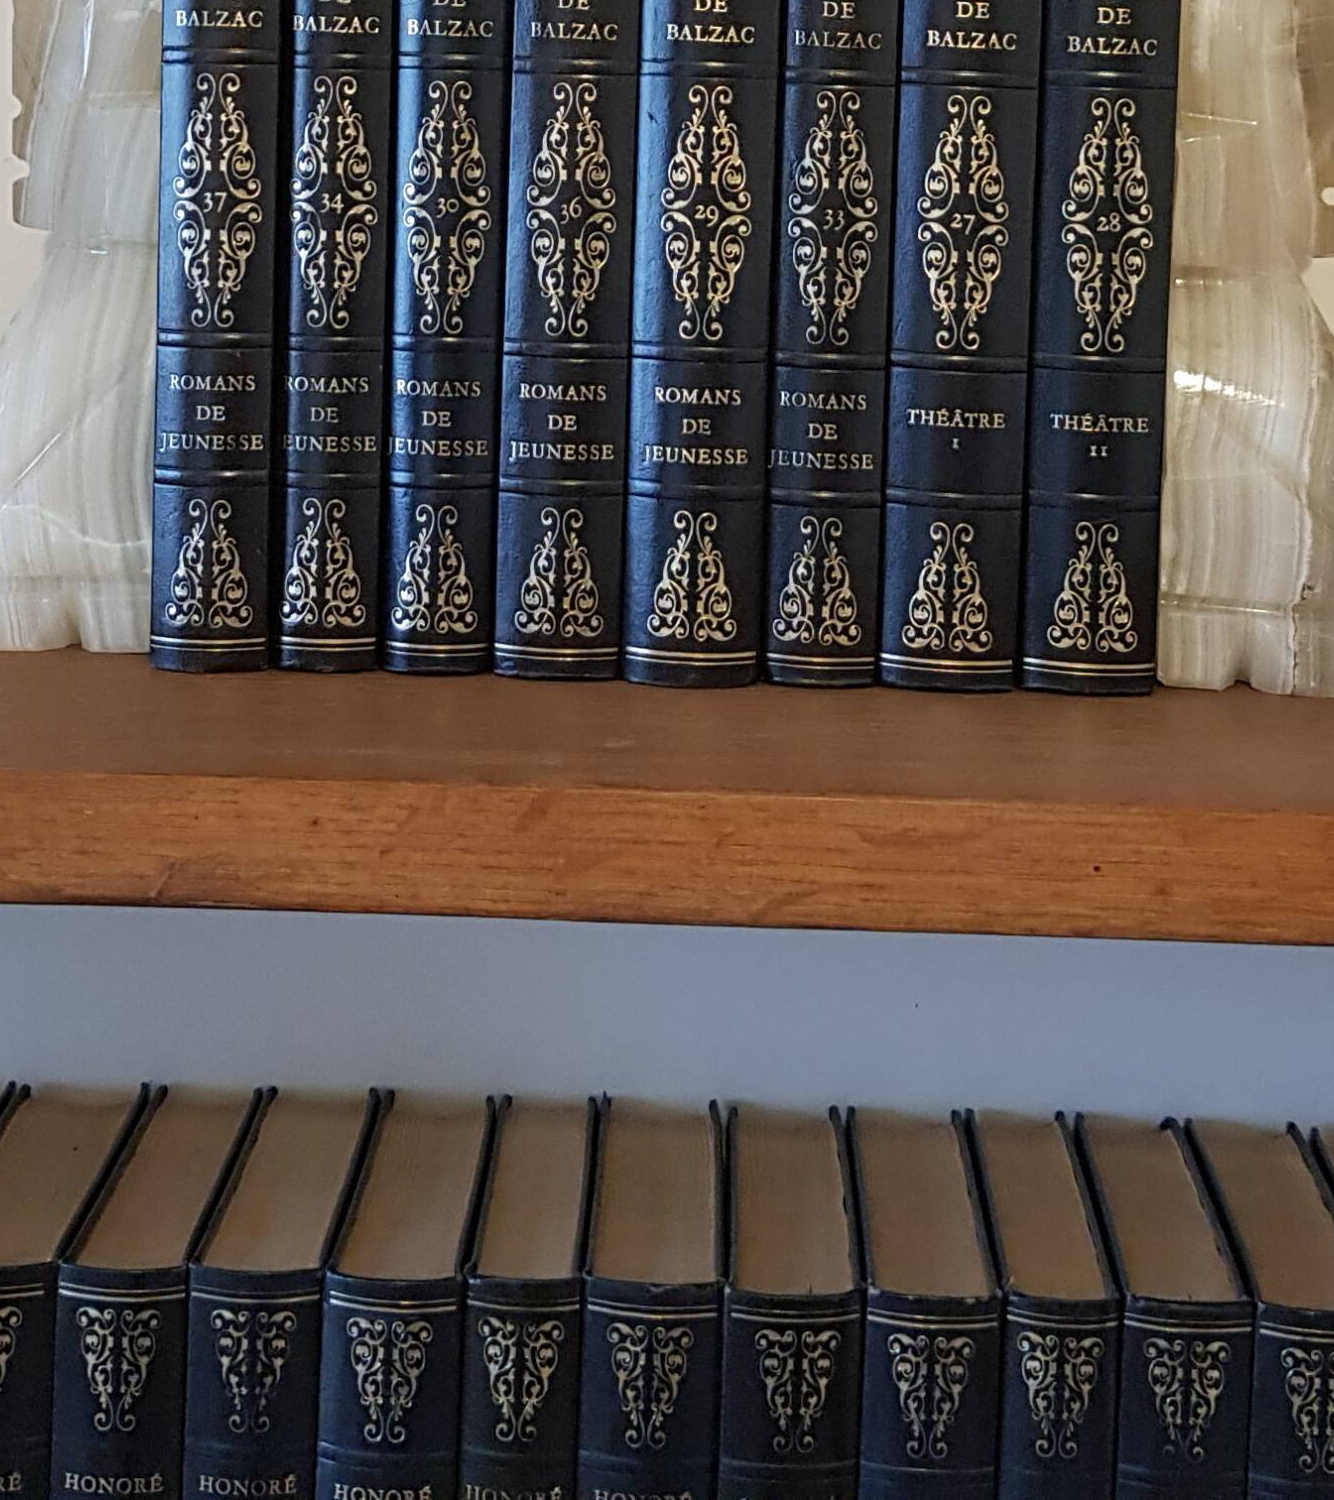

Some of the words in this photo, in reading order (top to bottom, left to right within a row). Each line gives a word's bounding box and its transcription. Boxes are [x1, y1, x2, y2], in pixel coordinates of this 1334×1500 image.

[175, 10, 263, 28] BALZAC
[822, 1, 855, 19] DE
[956, 1, 990, 20] DE
[1097, 7, 1131, 26] DE
[293, 15, 380, 34] BALZAC
[406, 18, 494, 37] BALZAC
[530, 21, 618, 41] BALZAC
[666, 23, 756, 44] BALZAC
[795, 29, 882, 50] BALZAC
[927, 30, 1017, 51] BALZAC
[1067, 36, 1158, 57] BALZAC
[169, 374, 256, 391] ROMANS
[284, 376, 369, 393] ROMANS
[395, 379, 481, 397] ROMANS
[519, 382, 607, 401] ROMANS
[653, 386, 742, 406] ROMANS
[779, 391, 867, 410] ROMANS
[195, 405, 226, 422] DE
[310, 407, 340, 423] DE
[421, 410, 452, 427] DE
[547, 414, 577, 431] DE
[906, 408, 1005, 429] THÉÂTRE
[1050, 412, 1150, 433] THÉÂTRE
[681, 418, 711, 435] DE
[808, 423, 838, 440] DE
[160, 433, 264, 453] JEUNESSE
[283, 434, 377, 452] EUNESSE
[387, 437, 489, 457] JEUNESSE
[509, 441, 614, 462] JEUNESSE
[644, 445, 748, 465] JEUNESSE
[767, 449, 874, 470] JEUNESSE
[64, 1472, 164, 1495] HONORÉ
[199, 1474, 297, 1496] HONORÉ
